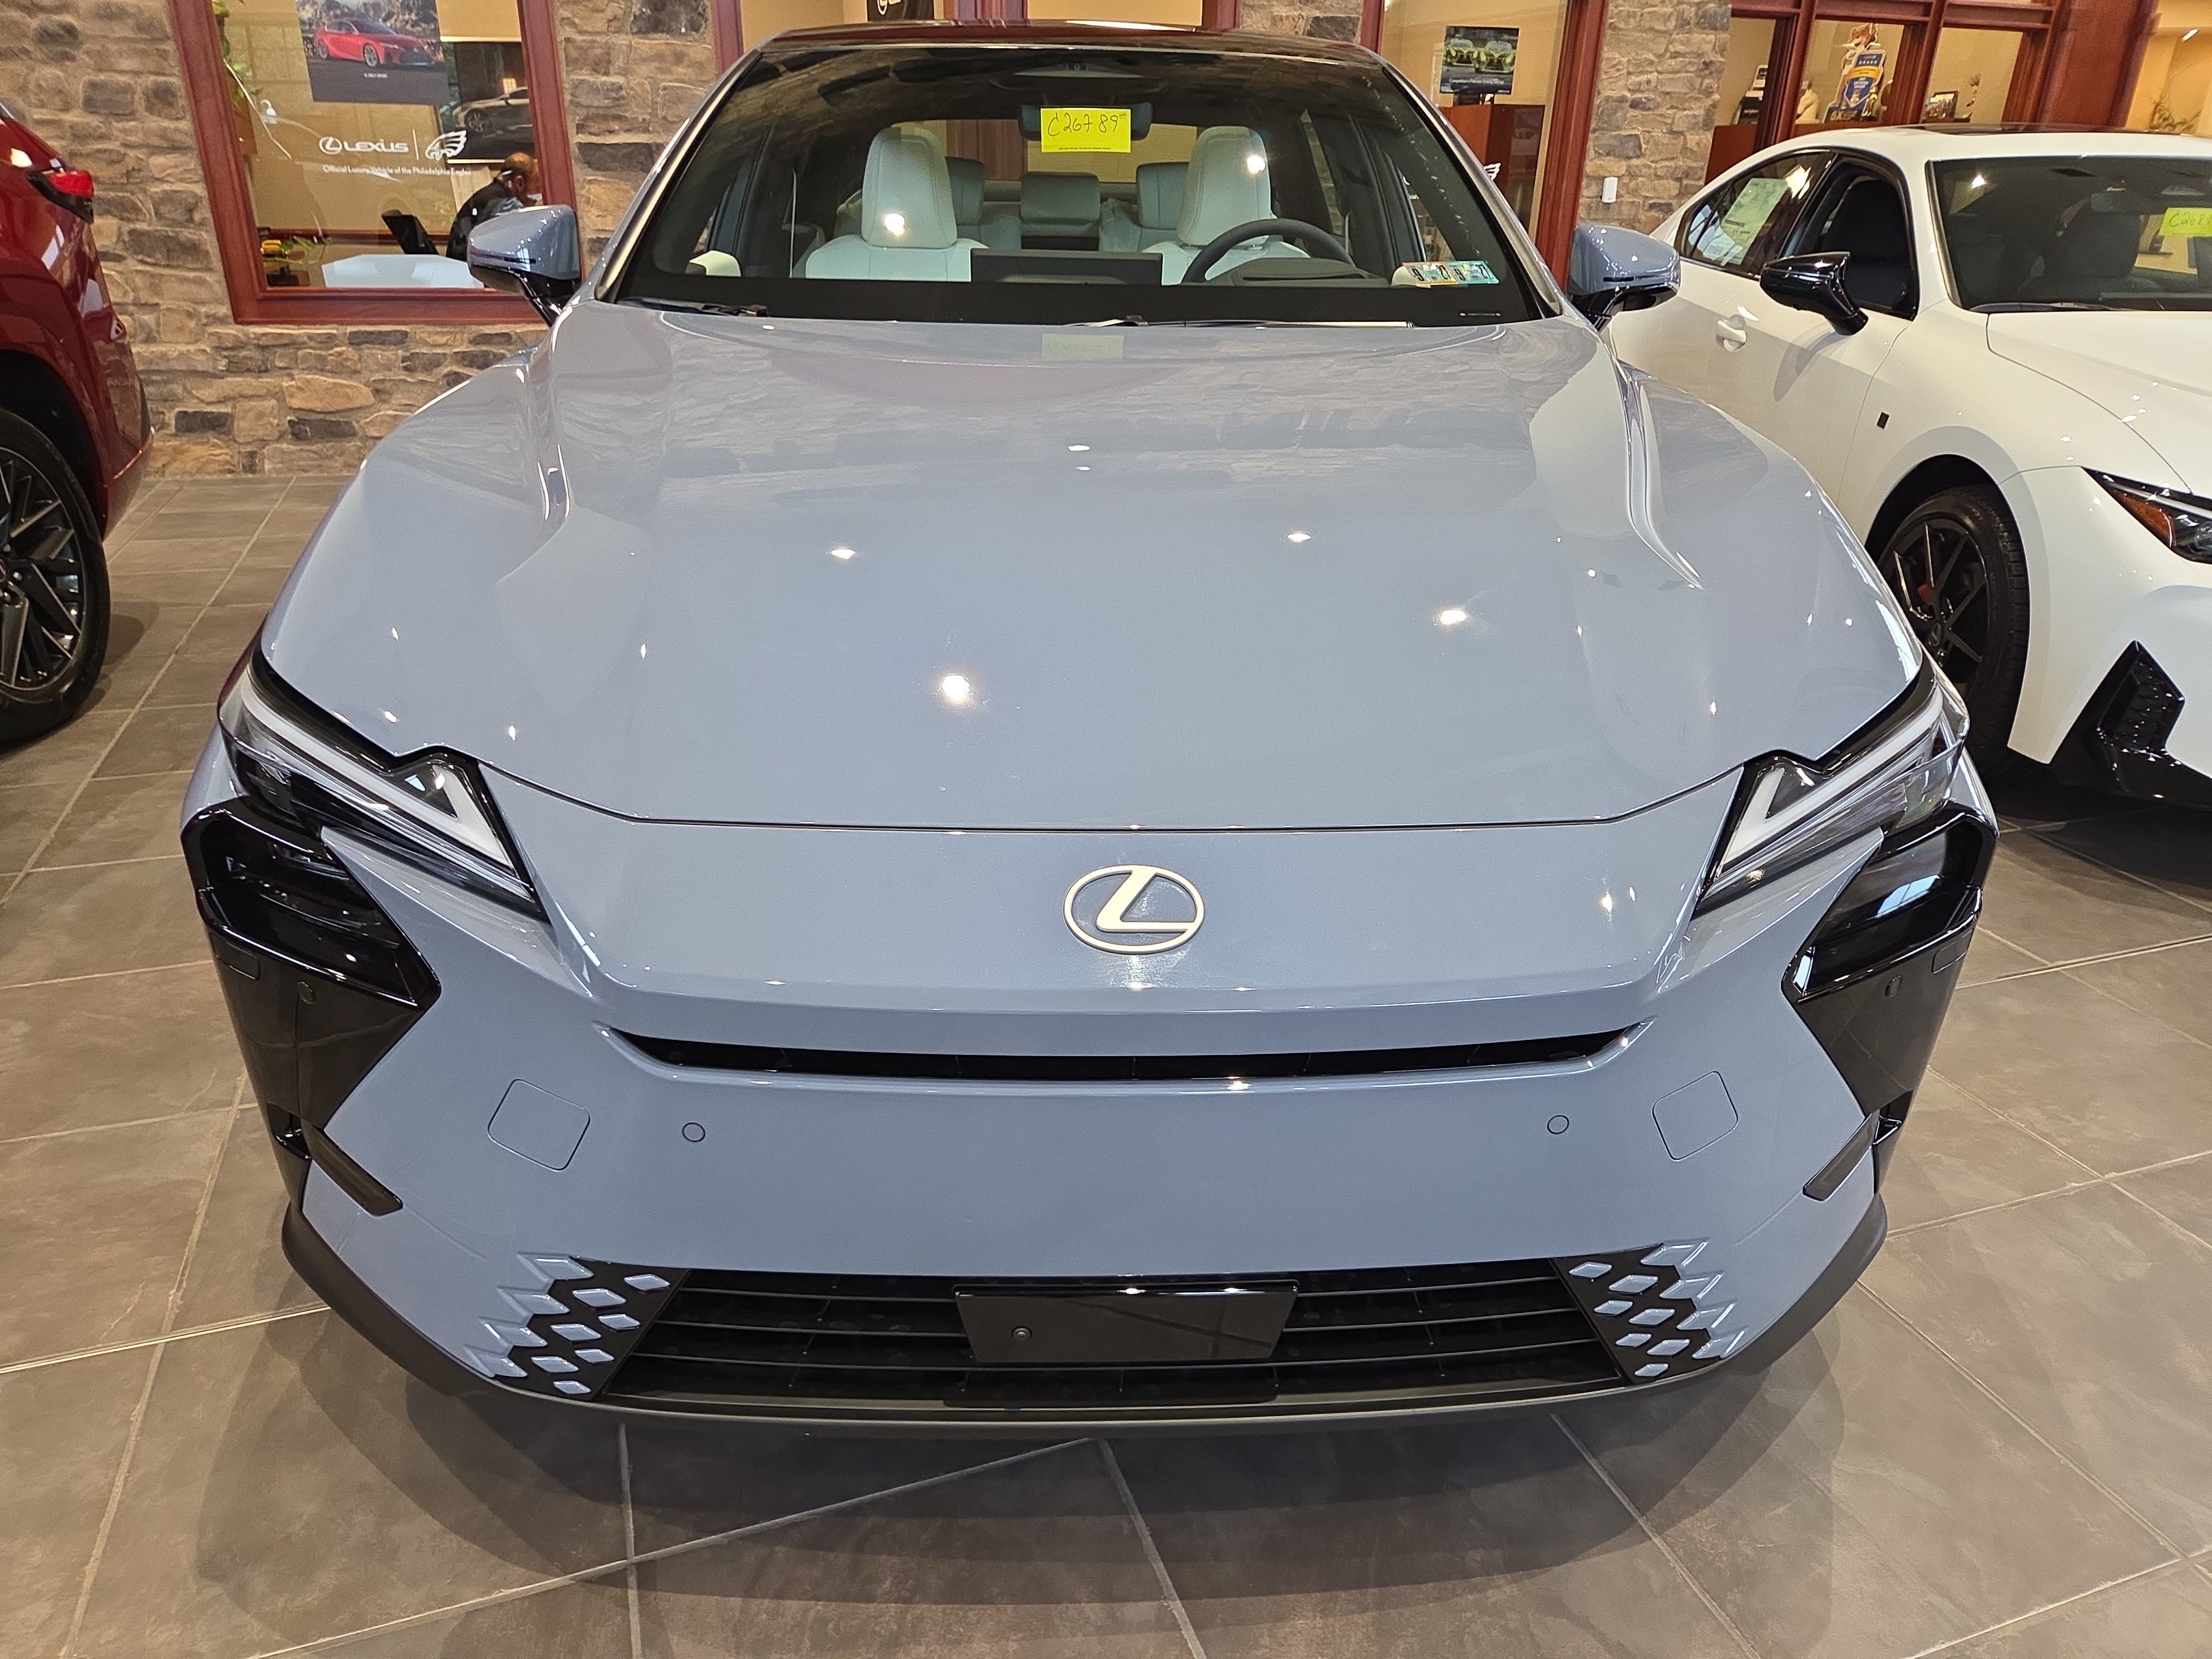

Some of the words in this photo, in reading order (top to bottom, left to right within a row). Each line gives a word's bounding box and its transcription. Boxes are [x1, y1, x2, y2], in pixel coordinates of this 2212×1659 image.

[343, 138, 409, 153] LEXUS
[323, 164, 347, 173] Official
[412, 166, 450, 176] Philadelphia
